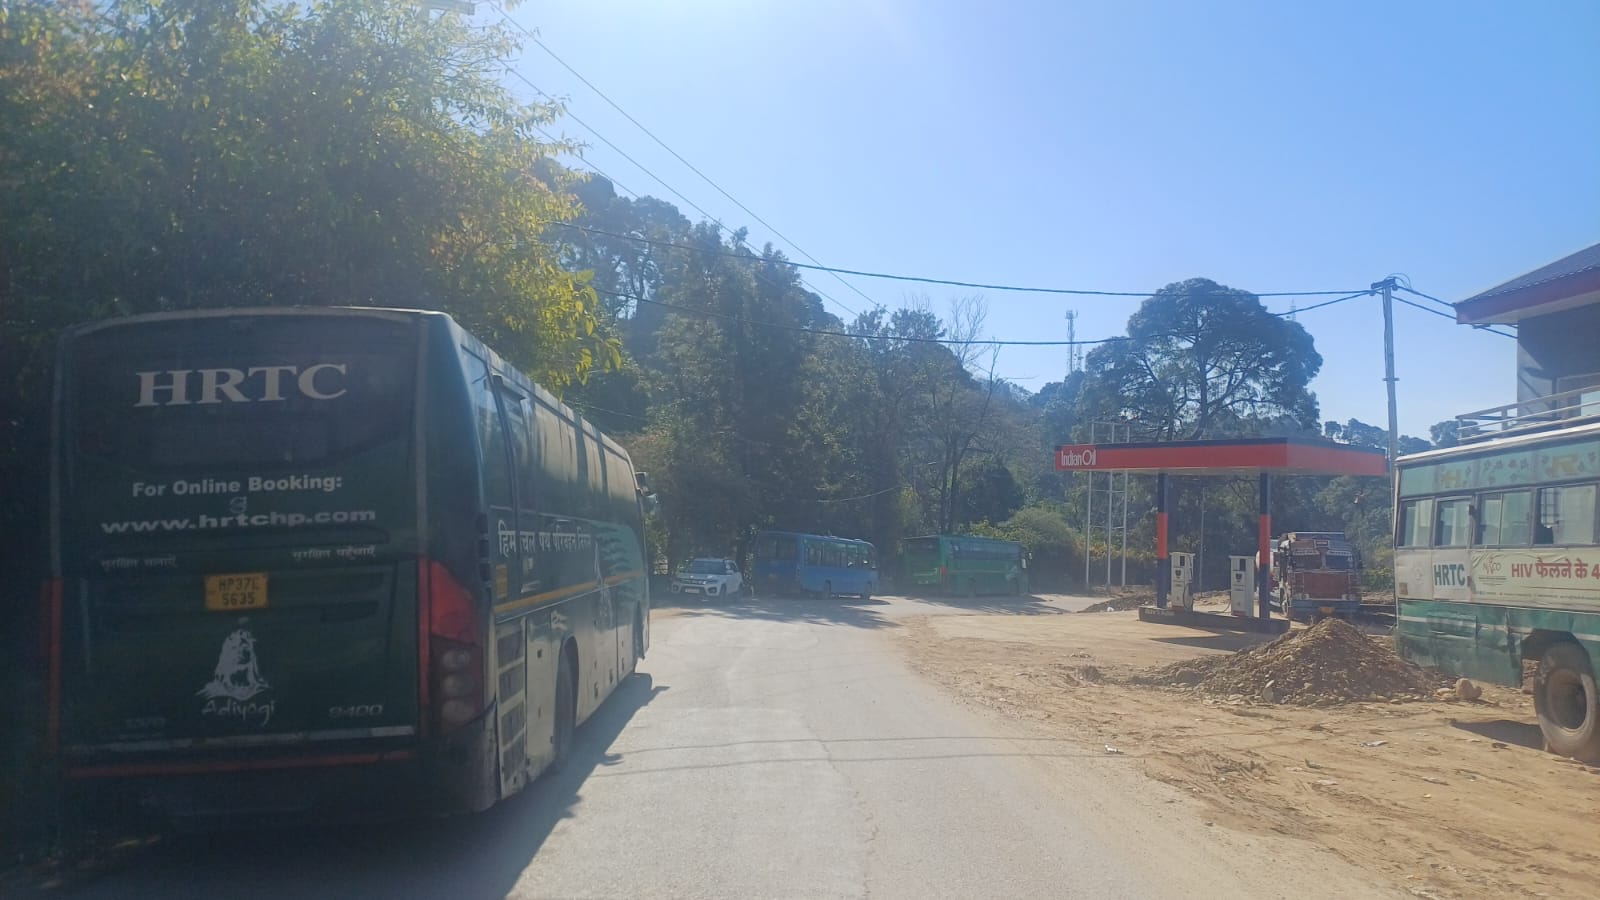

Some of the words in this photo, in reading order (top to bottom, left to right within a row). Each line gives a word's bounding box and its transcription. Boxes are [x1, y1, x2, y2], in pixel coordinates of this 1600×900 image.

[133, 363, 348, 408] HRTC
[132, 482, 168, 498] For
[172, 479, 241, 495] Online
[248, 475, 343, 493] Booking:
[101, 507, 377, 534] www.hrtchp.com
[1434, 564, 1466, 587] HRTC
[1511, 563, 1532, 578] HIV
[1535, 556, 1572, 579] फैलने
[1574, 558, 1589, 579] के
[201, 700, 275, 727] Adiyogi
[329, 704, 383, 718] 9400
